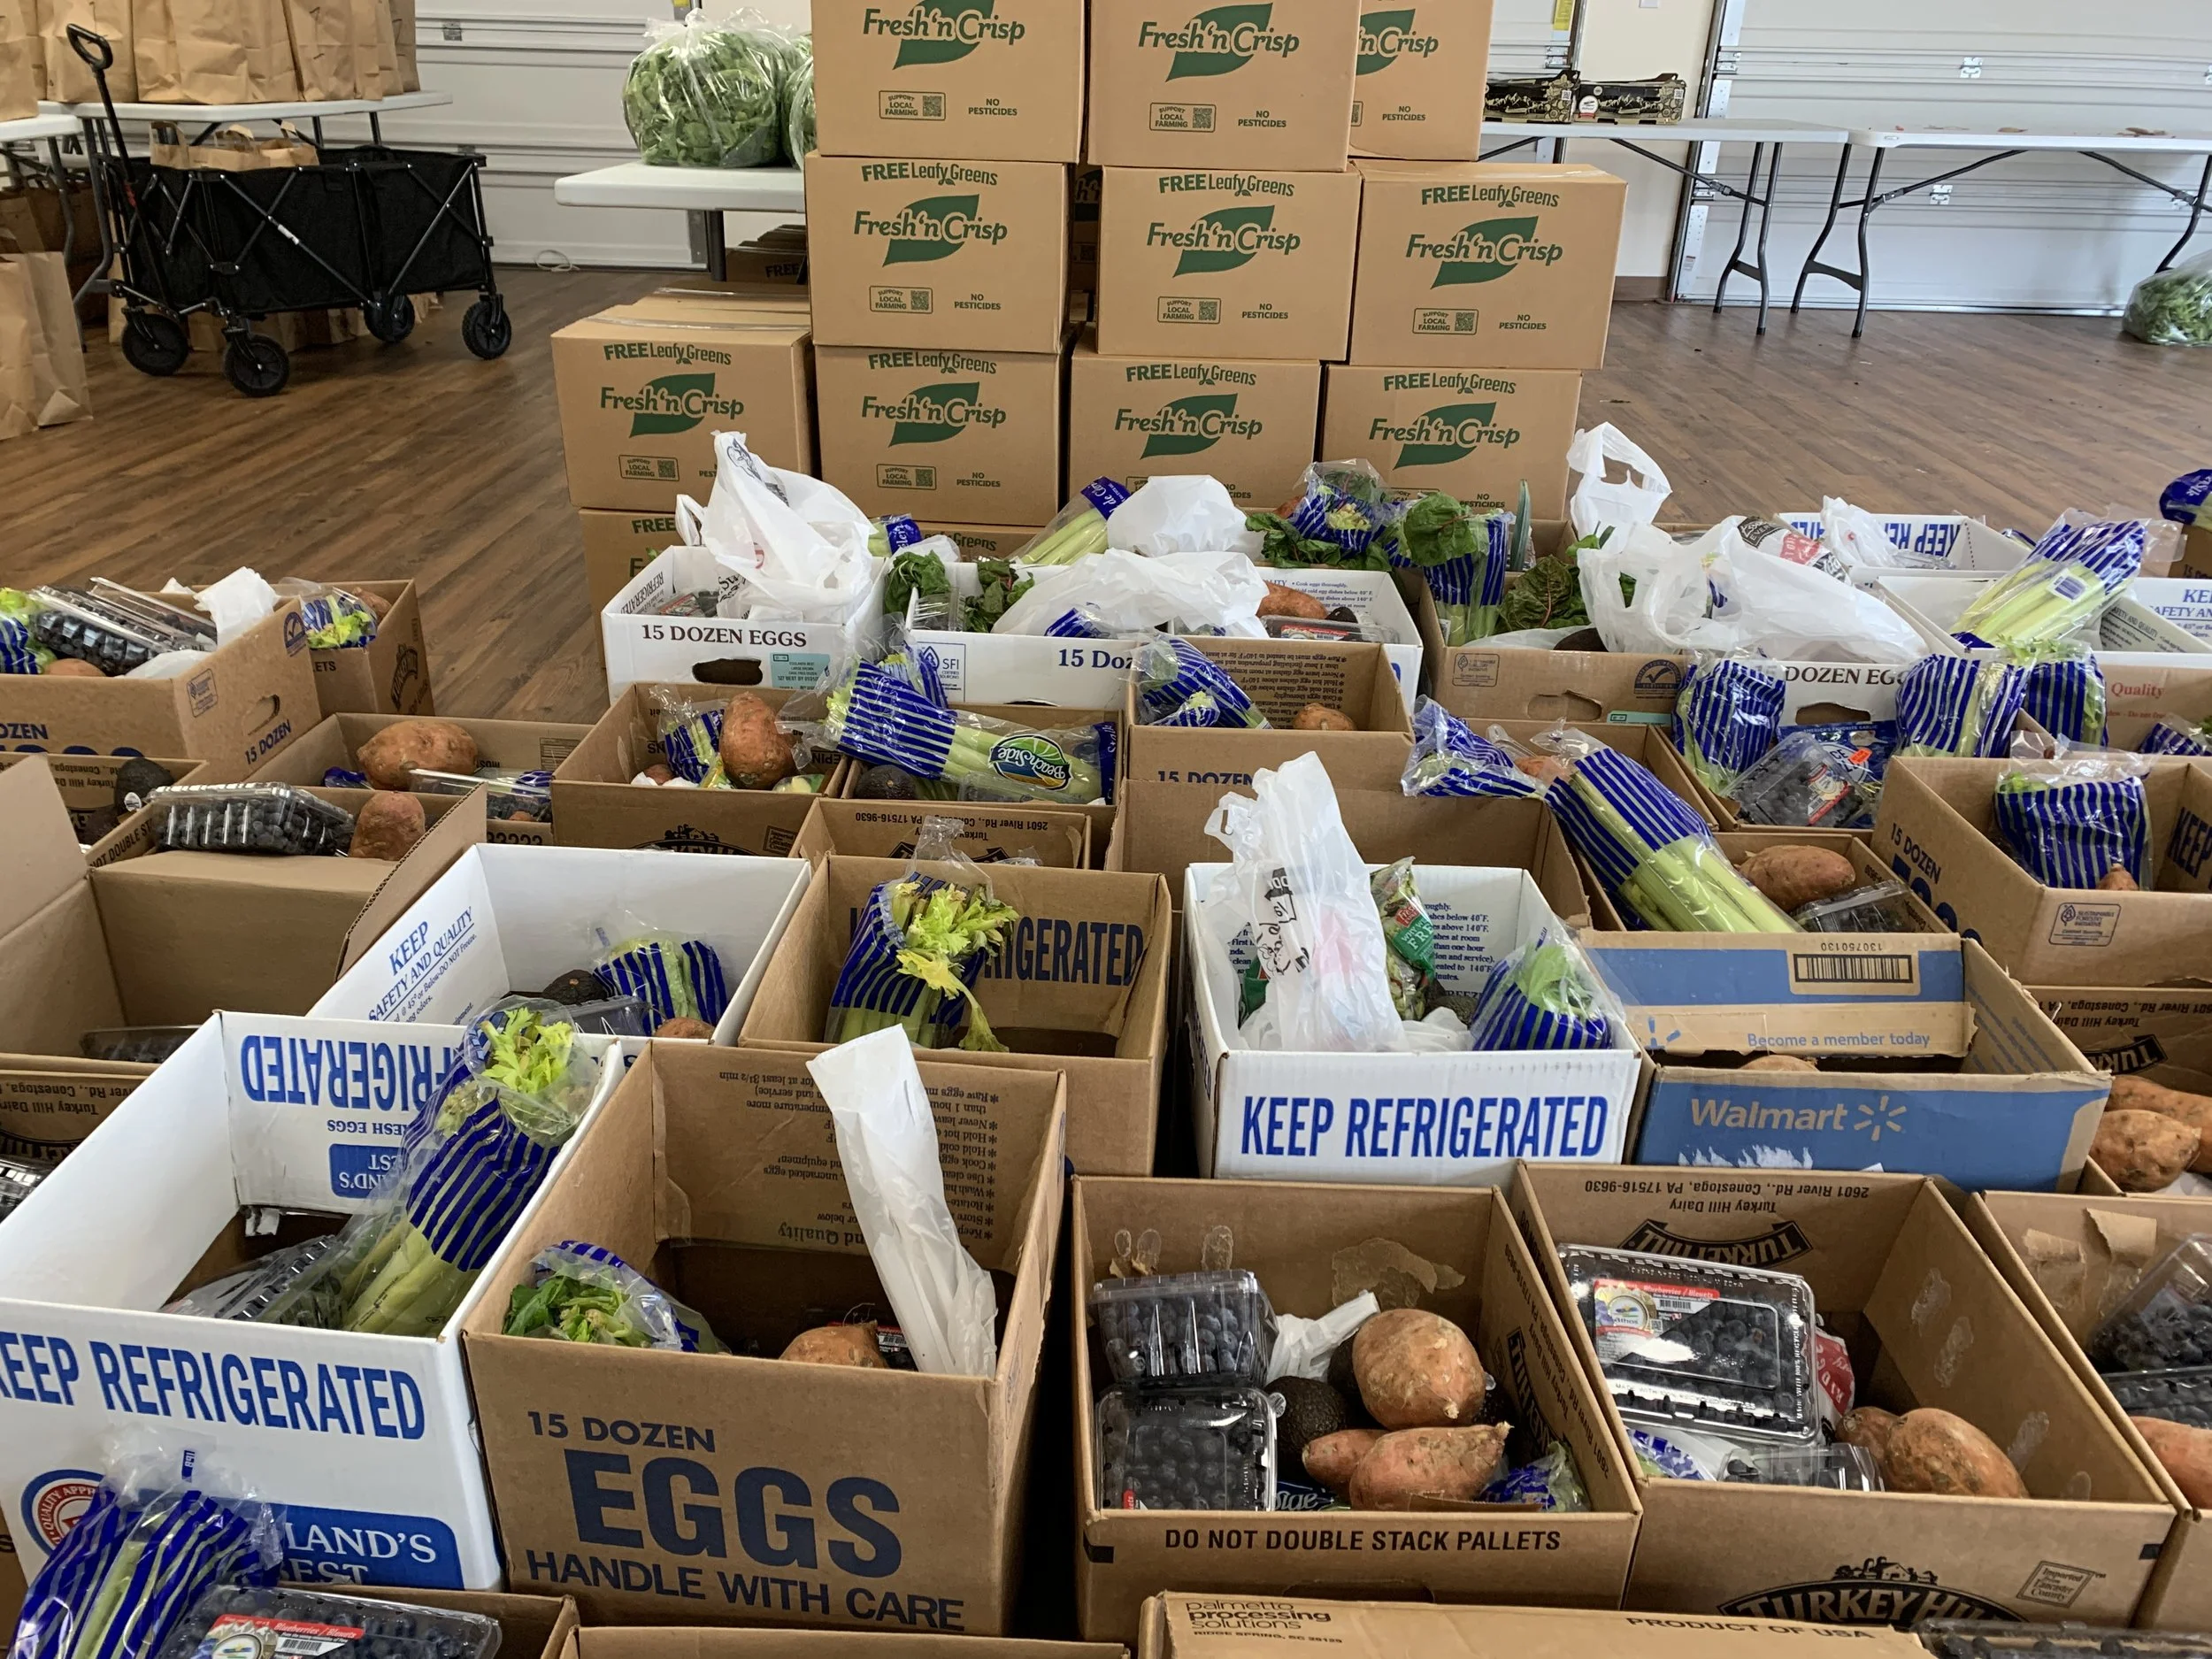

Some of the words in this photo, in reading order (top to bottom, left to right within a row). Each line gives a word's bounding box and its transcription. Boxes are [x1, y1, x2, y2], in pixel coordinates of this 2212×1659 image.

[958, 13, 1025, 44] Crisp
[1233, 26, 1299, 58] Crisp
[1380, 31, 1439, 58] Crisp
[968, 107, 1018, 116] PESTICIDES
[862, 163, 910, 181] FREE
[911, 163, 949, 185] Leafy
[950, 164, 998, 185] Greens
[1159, 174, 1206, 193] FREE
[1209, 173, 1245, 196] Leafy
[1248, 175, 1294, 196] Greens
[1422, 186, 1470, 204] FREE
[1472, 185, 1509, 208] Leafy
[1511, 186, 1559, 207] Greens
[944, 215, 1008, 245] Crisp
[1238, 227, 1301, 255] Crisp
[1499, 238, 1563, 265] Crisp
[603, 343, 649, 360] FREE
[650, 343, 686, 365] Leafy
[687, 344, 731, 365] Greens
[869, 352, 914, 370] FREE
[916, 352, 951, 373] Leafy
[952, 354, 996, 374] Greens
[1126, 364, 1171, 381] FREE
[1174, 364, 1210, 385] Leafy
[1211, 365, 1256, 385] Greens
[1384, 373, 1430, 391] FREE
[1432, 373, 1468, 394] Leafy
[1470, 374, 1516, 394] Greens
[685, 393, 744, 419] Crisp
[947, 402, 1006, 428] Crisp
[1202, 413, 1262, 439] Crisp
[1458, 422, 1519, 449] Crisp
[642, 625, 664, 640] 15
[670, 626, 743, 644] DOZEN
[749, 631, 806, 647] EGGS
[942, 658, 959, 670] SFI
[1059, 649, 1084, 666] 15
[1786, 667, 1861, 684] DOZEN
[2111, 682, 2164, 699] Quality
[0, 723, 48, 739] OZEN
[258, 719, 291, 749] DOZEN
[998, 747, 1065, 779] BeachSide
[856, 812, 908, 824] 17516-9630
[1000, 819, 1023, 829] River
[1026, 821, 1048, 831] 2601
[1891, 823, 1903, 845] 15
[1903, 836, 1941, 884] DOZEN
[389, 921, 428, 976] KEEP
[411, 952, 431, 983] AND
[434, 906, 472, 957] QUALITY
[1821, 942, 1883, 951] 130750130
[2068, 1000, 2129, 1012] Conestoga,
[2159, 1002, 2189, 1013] River
[2083, 1018, 2102, 1027] Hill
[2106, 1017, 2139, 1027] Turkey
[1747, 1033, 1806, 1048] Become
[1811, 1035, 1819, 1047] a
[1824, 1033, 1885, 1046] member
[1888, 1032, 1931, 1048] today
[719, 1071, 738, 1081] min
[762, 1075, 786, 1087] least
[6, 1082, 75, 1097] Conestoga,
[755, 1085, 793, 1098] service)
[795, 1088, 814, 1099] and
[941, 1087, 964, 1100] eggs
[966, 1091, 988, 1102] Raw
[32, 1102, 54, 1113] Hill
[58, 1101, 98, 1115] Turkey
[746, 1100, 772, 1110] more
[964, 1103, 987, 1115] than
[1691, 1098, 1847, 1132] Walmart
[327, 1119, 366, 1133] EGGS
[958, 1118, 987, 1129] Never
[1240, 1095, 1334, 1156] KEEP
[1345, 1095, 1609, 1158] REFRIGERATED
[943, 1131, 960, 1142] hot
[963, 1132, 987, 1143] Hold
[940, 1143, 959, 1156] cold
[962, 1145, 986, 1157] Hold
[763, 1164, 786, 1176] eggs
[962, 1158, 986, 1170] Cook
[787, 1168, 838, 1182] uncracked
[966, 1172, 985, 1184] Use
[1585, 1181, 1662, 1193] 17516-9630
[1667, 1182, 1683, 1194] PA
[1689, 1183, 1762, 1196] Conestoga,
[1767, 1184, 1792, 1196] Rd.,
[1797, 1185, 1831, 1196] River
[1837, 1187, 1870, 1198] 2601
[1670, 1198, 1703, 1211] Dairy
[1709, 1199, 1731, 1213] Hill
[1736, 1199, 1777, 1213] Turkey
[818, 1212, 844, 1225] below
[777, 1223, 839, 1245] Quality
[89, 1340, 426, 1440] REFRIGERATED
[527, 1411, 569, 1439] 15
[582, 1417, 715, 1453] DOZEN
[41, 1493, 62, 1530] QUALITY
[564, 1448, 902, 1578] EGGS
[1165, 1529, 1198, 1549] DO
[1212, 1530, 1258, 1549] NOT
[1265, 1530, 1363, 1551] DOUBLE
[1371, 1531, 1448, 1552] STACK
[1456, 1531, 1561, 1551] PALLETS
[526, 1549, 706, 1599] HANDLE
[717, 1571, 830, 1615] WITH
[846, 1587, 964, 1631] CARE
[1186, 1600, 1294, 1611] palmetto
[1737, 1588, 1916, 1622] TURKEY
[1189, 1610, 1331, 1622] processing
[1192, 1619, 1302, 1630] solutions
[1626, 1617, 1760, 1632] PRODUCT
[1769, 1624, 1803, 1634] OF
[1817, 1628, 1875, 1640] USA
